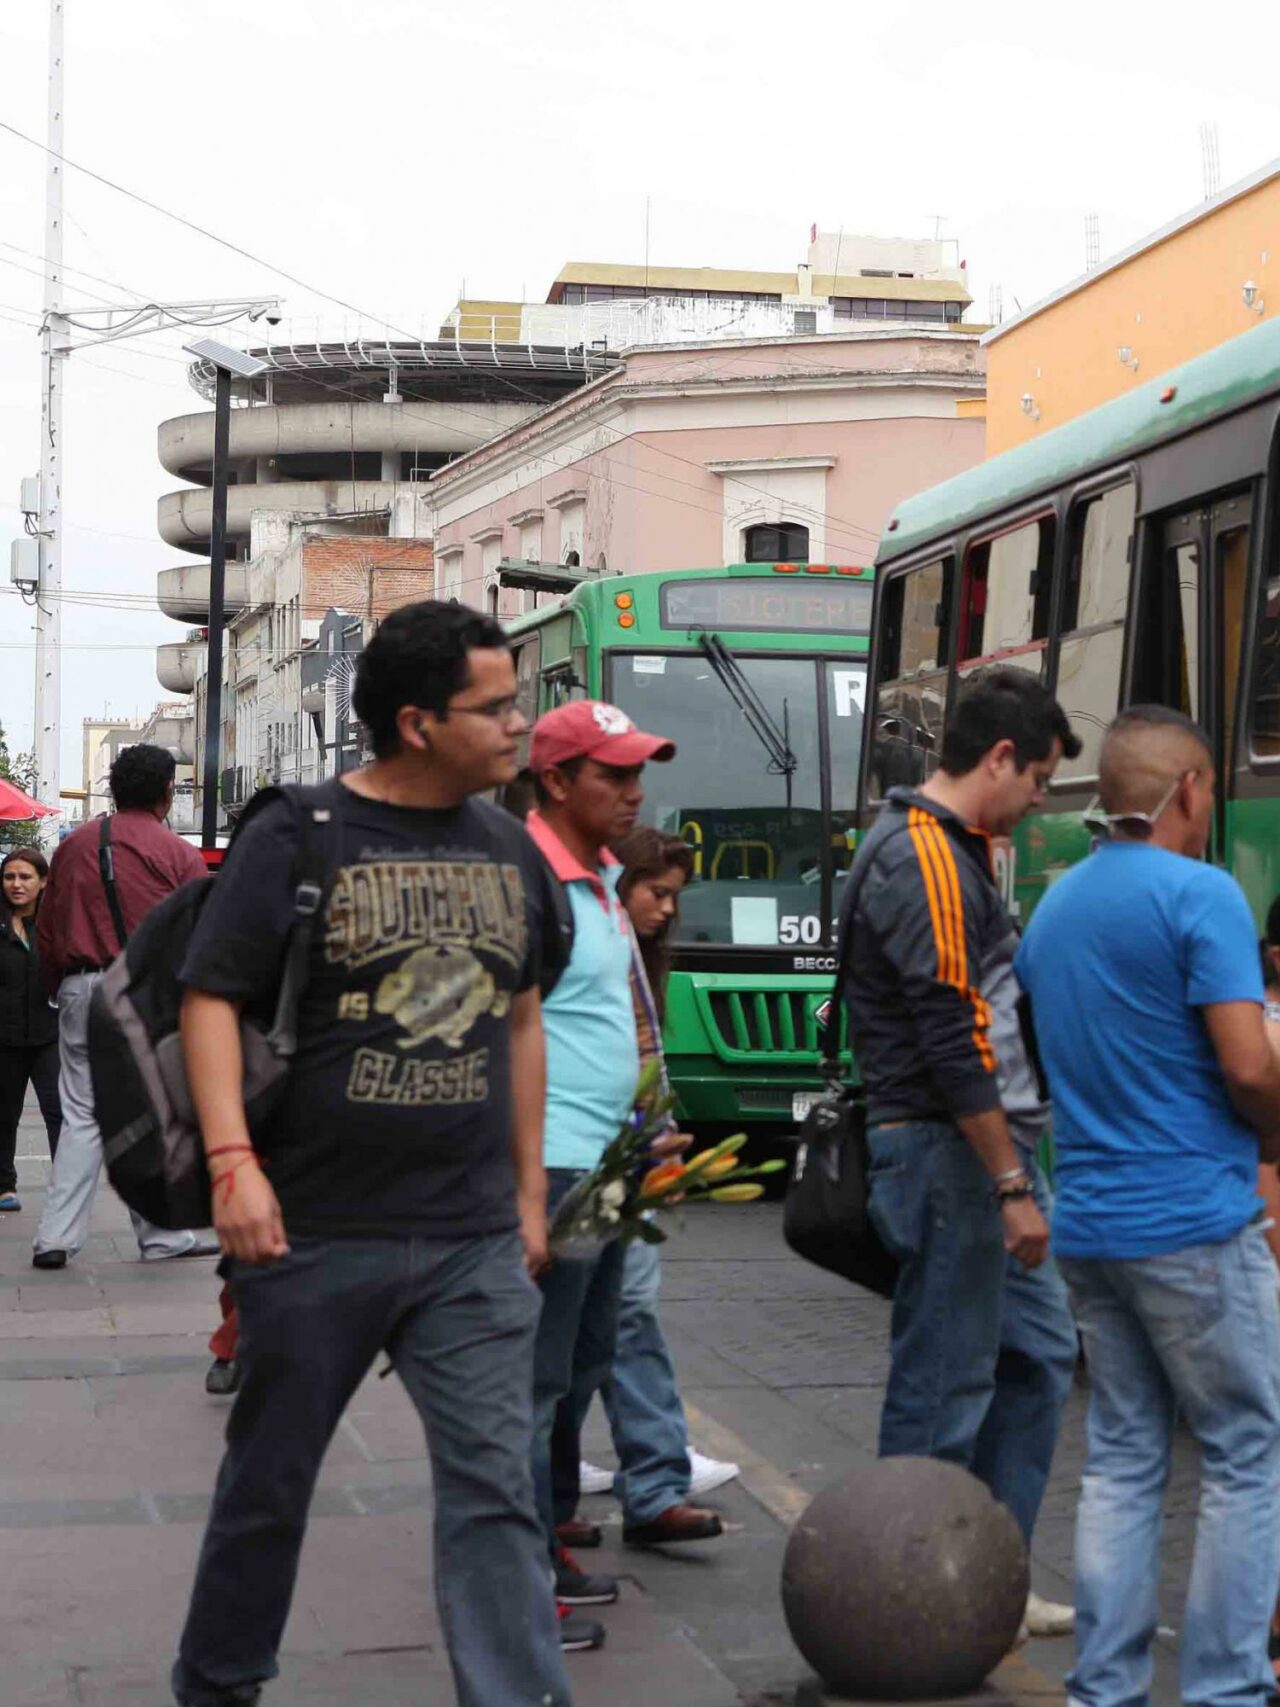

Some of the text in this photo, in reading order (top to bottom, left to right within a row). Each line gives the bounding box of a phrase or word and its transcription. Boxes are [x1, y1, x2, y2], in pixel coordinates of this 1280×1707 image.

[324, 860, 528, 965] SOUTHPOL
[793, 956, 840, 971] BECC
[346, 1047, 490, 1105] CLASSIC
